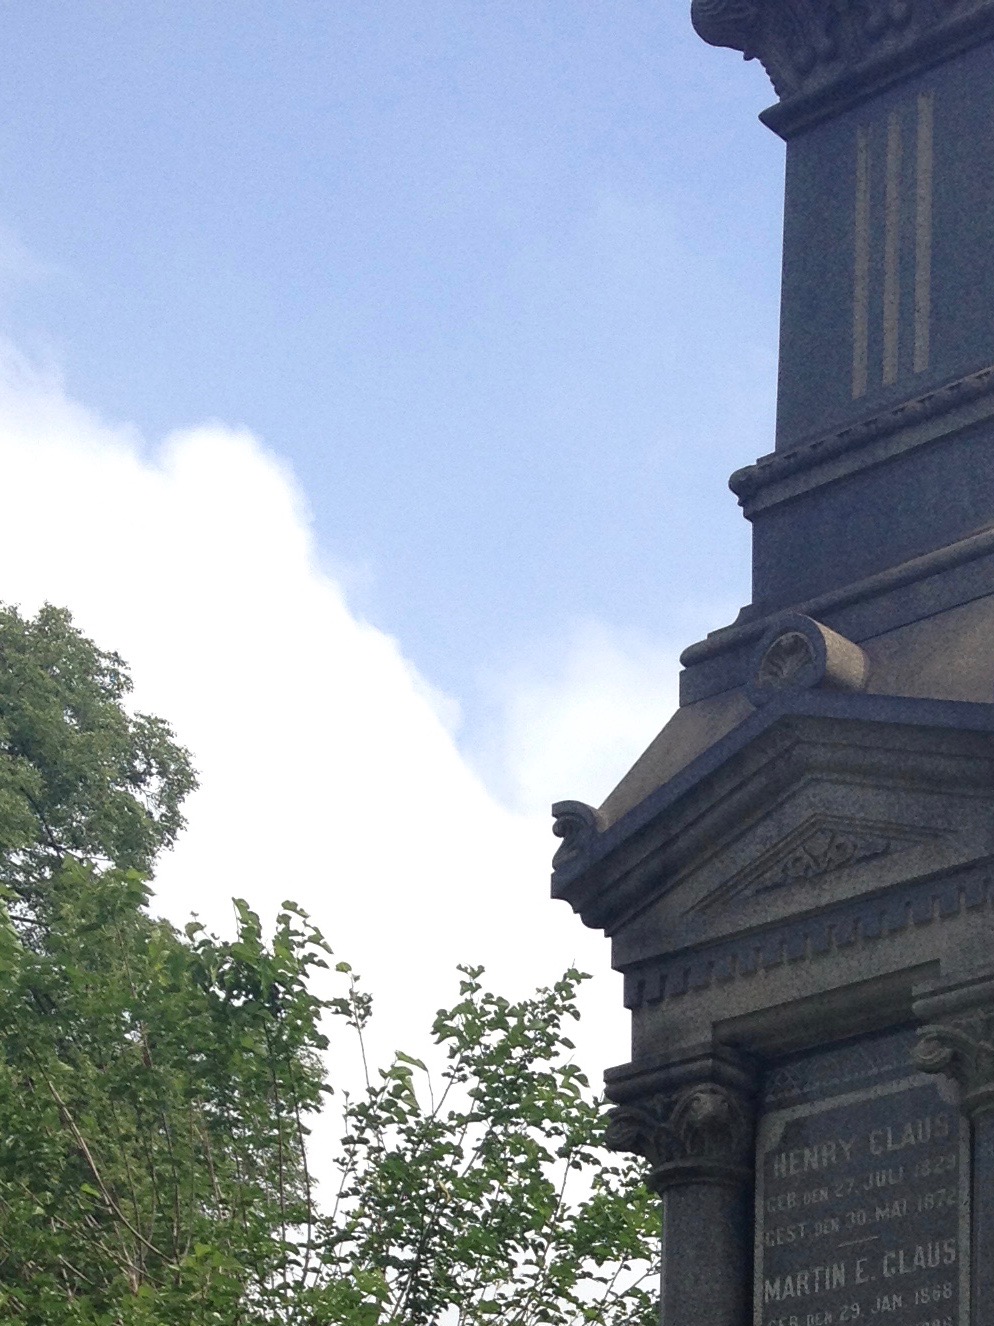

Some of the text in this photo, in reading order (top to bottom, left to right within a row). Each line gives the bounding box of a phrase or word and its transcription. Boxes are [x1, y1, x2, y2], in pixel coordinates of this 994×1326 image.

[773, 1113, 949, 1179] HENRY CLAUS
[876, 1199, 907, 1222] MAI
[764, 1238, 956, 1303] MARTIN E. CLAUS
